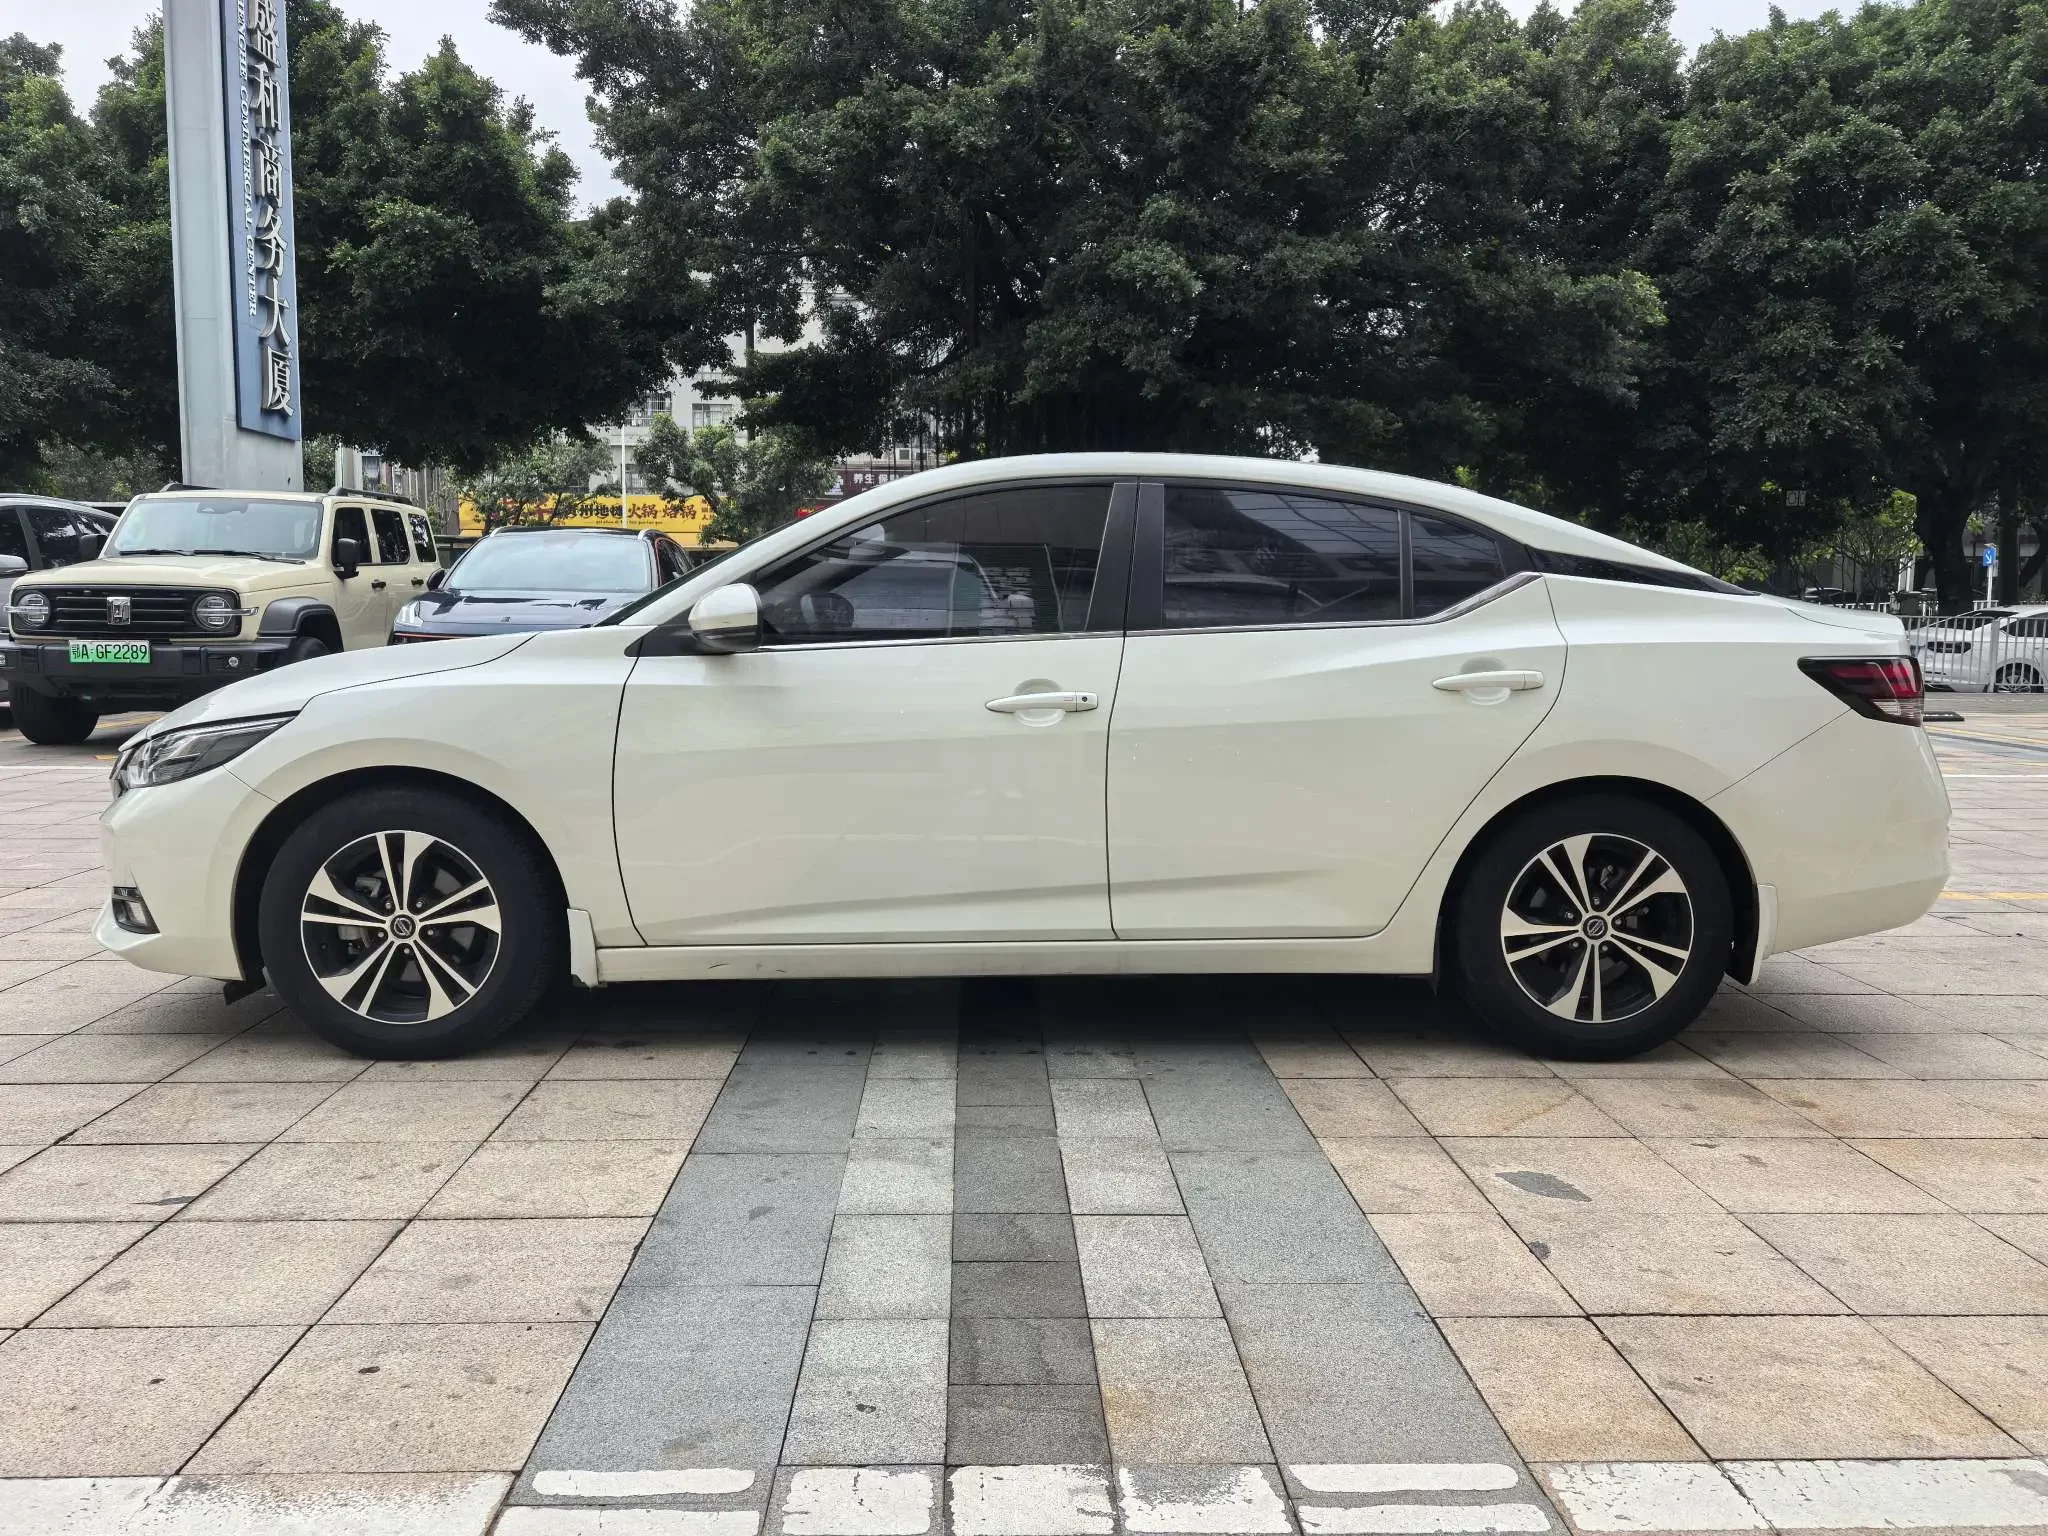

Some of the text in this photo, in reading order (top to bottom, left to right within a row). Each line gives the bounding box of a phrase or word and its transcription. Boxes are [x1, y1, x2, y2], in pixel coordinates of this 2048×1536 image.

[241, 86, 252, 230] COMMERCIAL
[249, 0, 294, 416] 盛和商务大厦
[246, 235, 257, 317] CENTER
